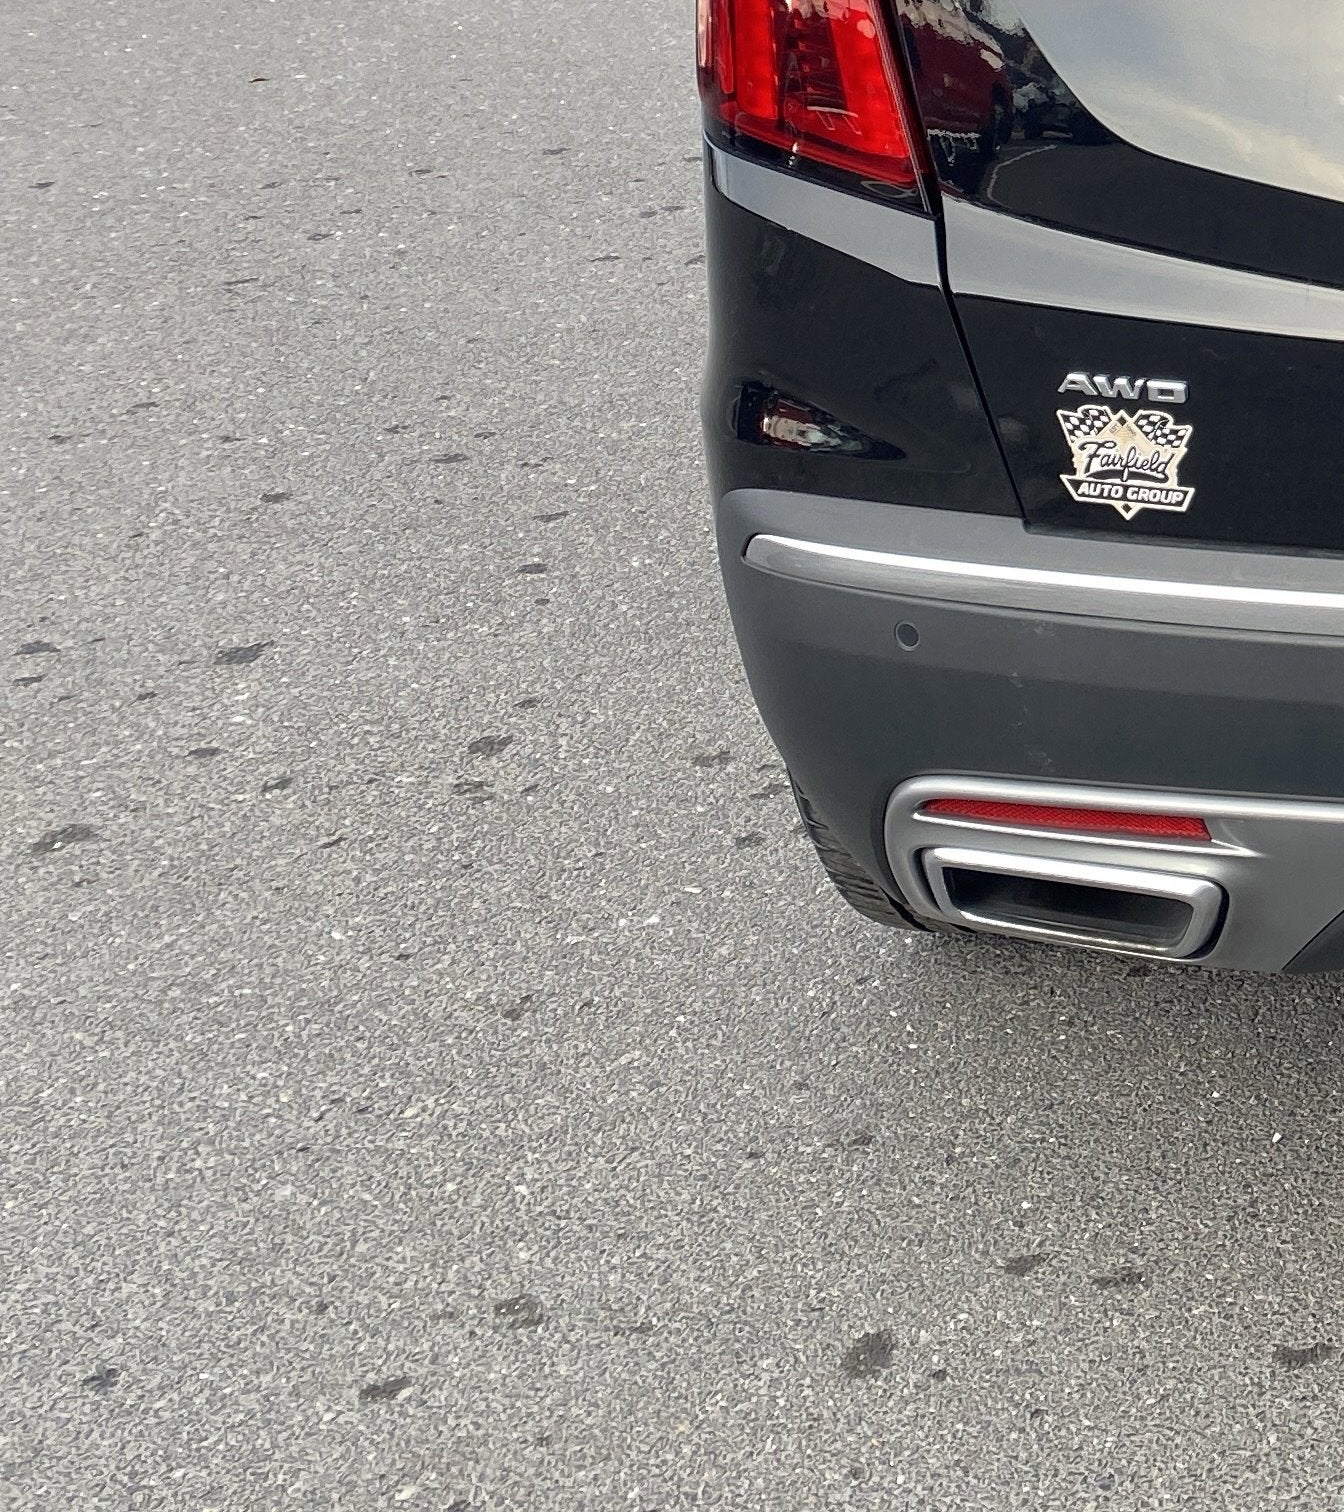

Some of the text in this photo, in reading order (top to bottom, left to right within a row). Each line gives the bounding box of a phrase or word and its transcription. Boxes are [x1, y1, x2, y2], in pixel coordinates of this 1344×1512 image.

[1057, 371, 1190, 404] AWD
[1079, 440, 1175, 483] Fairfield
[1077, 484, 1186, 505] AUTO GROUP
